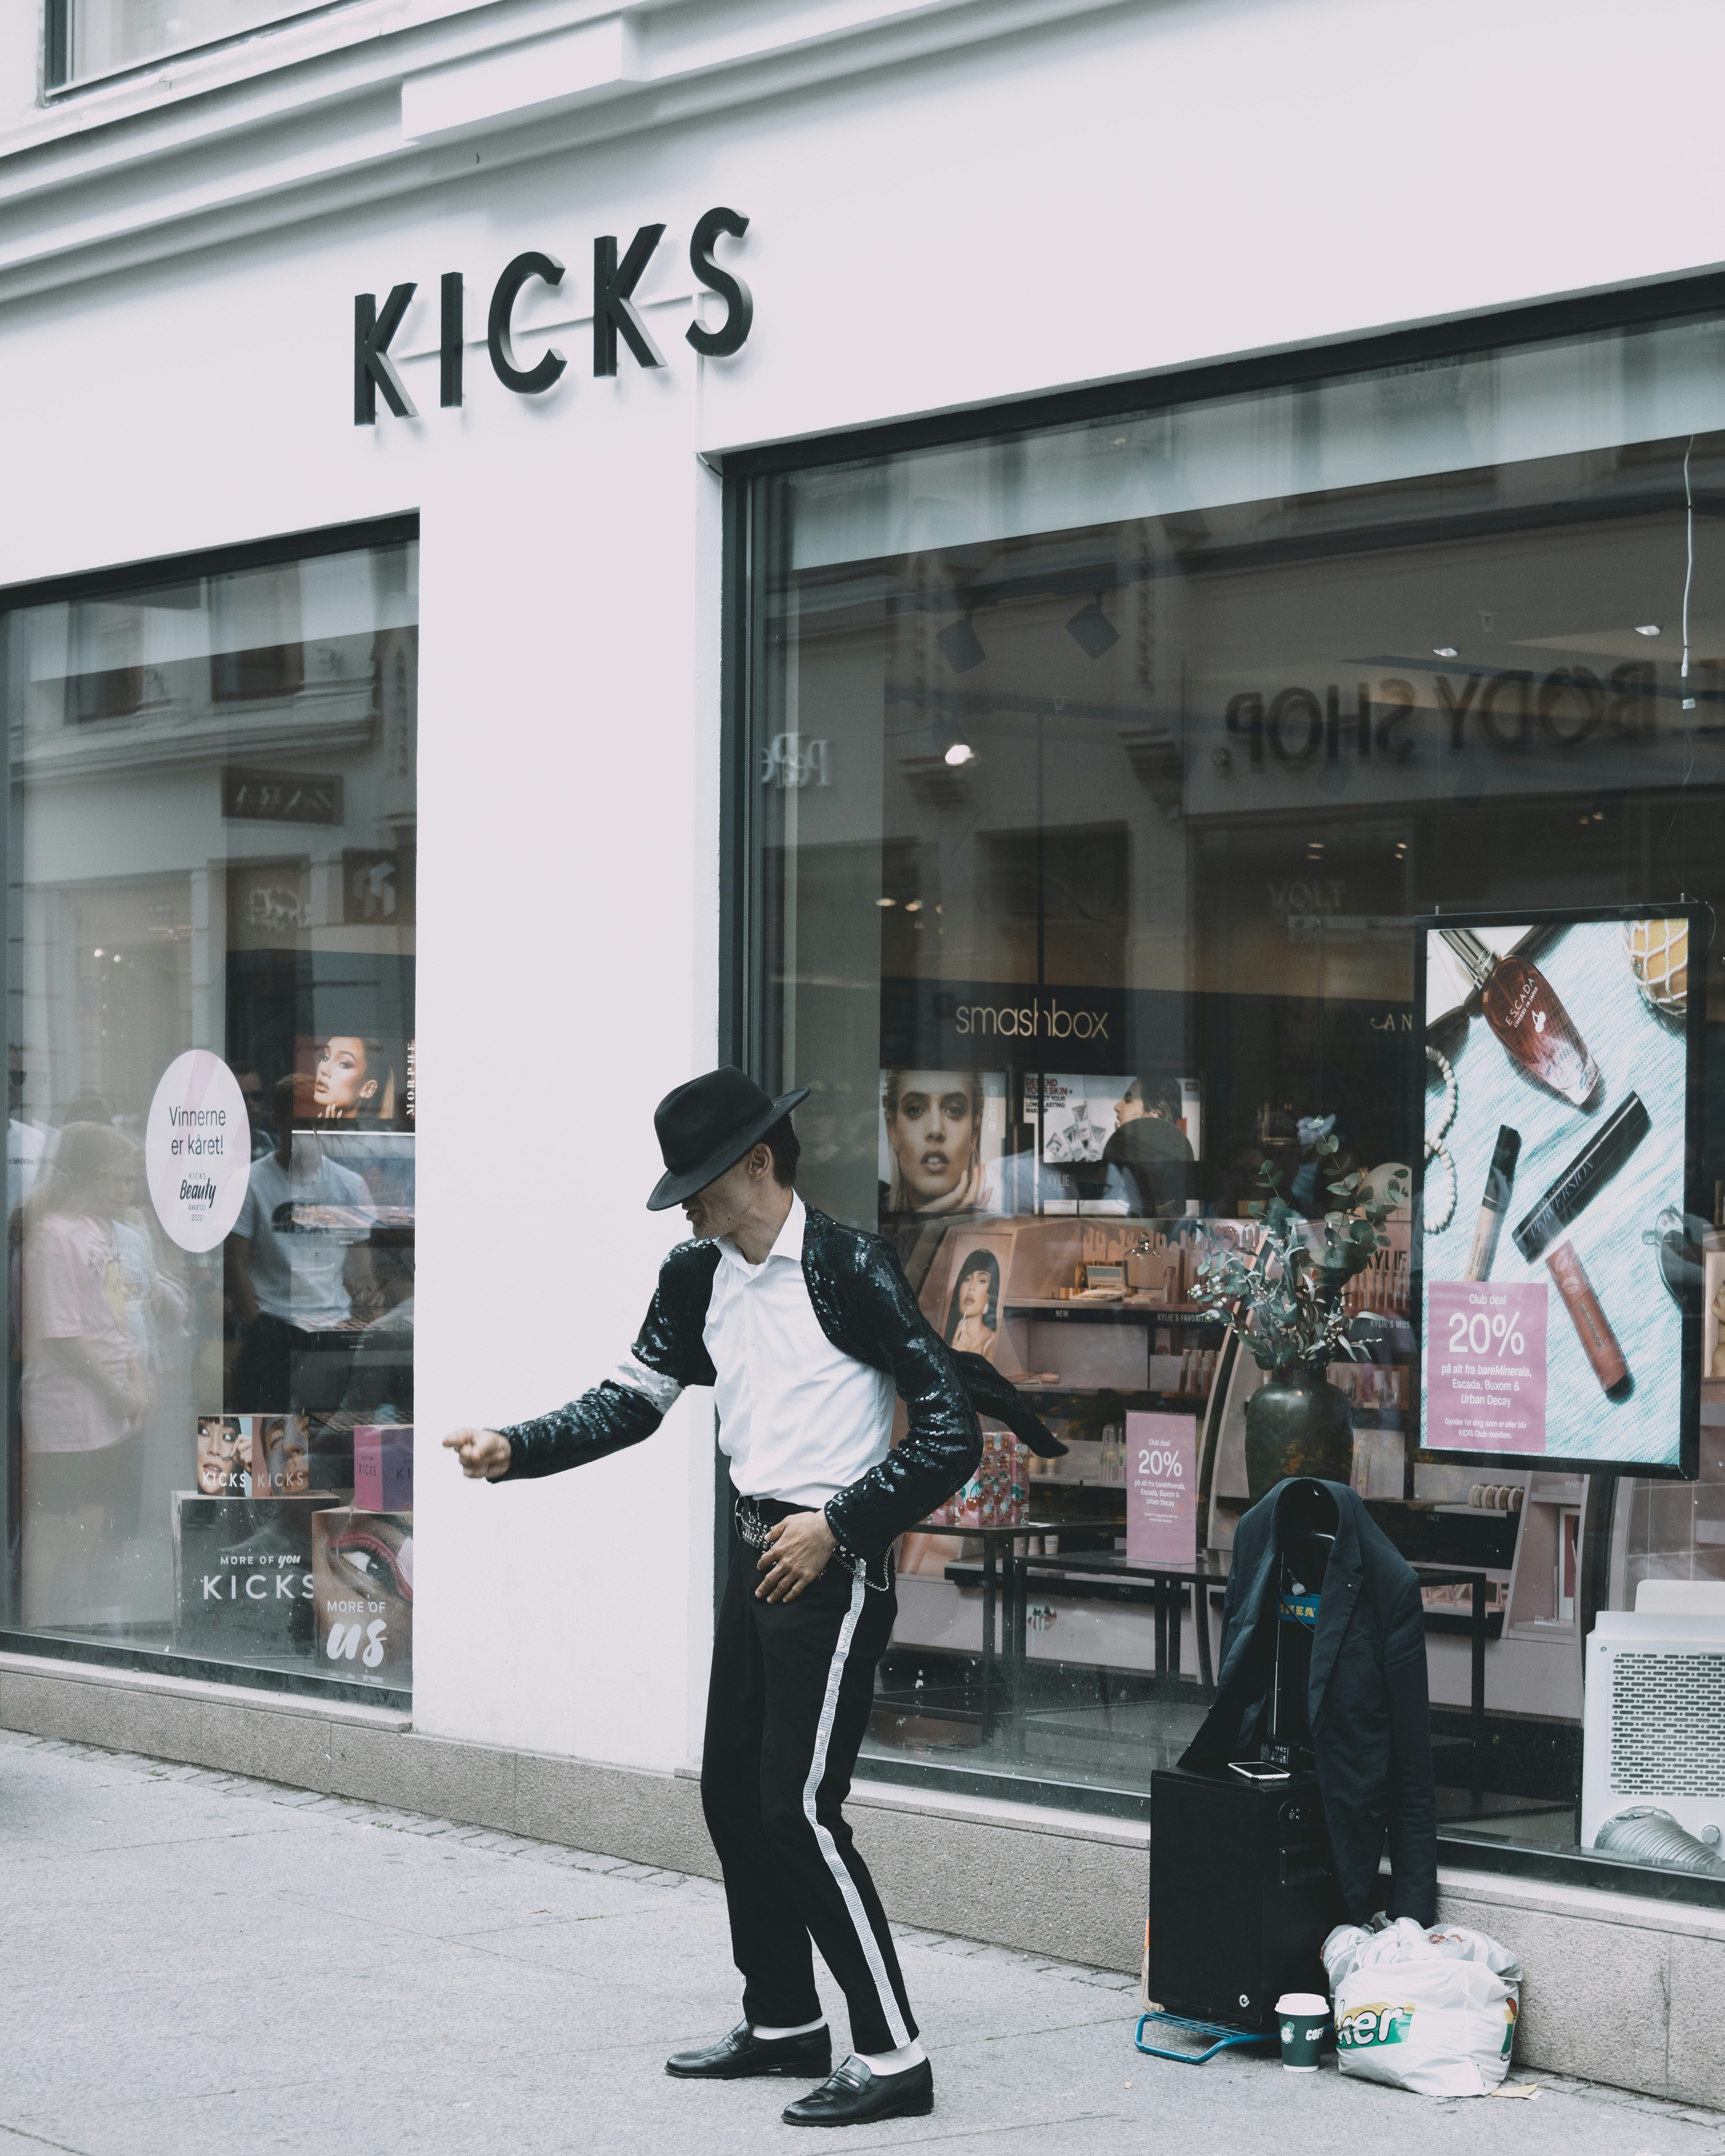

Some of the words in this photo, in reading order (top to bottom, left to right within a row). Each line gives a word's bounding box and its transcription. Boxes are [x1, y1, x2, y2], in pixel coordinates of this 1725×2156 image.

[354, 207, 753, 427] KICKS
[1505, 978, 1535, 1026] ESCADA
[1514, 1007, 1527, 1028] CHERRY
[1525, 1000, 1531, 1009] IN
[1529, 986, 1538, 1002] JAPAN
[956, 997, 1109, 1039] smashbox
[407, 1043, 415, 1116] MORPHE
[169, 1106, 226, 1126] Vinnerne
[171, 1139, 183, 1155] er
[188, 1134, 223, 1155] kåret!
[180, 1177, 216, 1209] Beauty
[1530, 1158, 1593, 1239] PERVERSION
[1469, 1294, 1487, 1304] Club
[1489, 1295, 1506, 1305] deal
[1157, 1313, 1179, 1322] KYLIE'S
[1370, 1320, 1394, 1328] KYLIE'S
[1448, 1311, 1525, 1358] 20%
[1441, 1363, 1451, 1376] på
[1453, 1363, 1463, 1374] alt
[1465, 1363, 1475, 1374] fra
[1477, 1364, 1532, 1378] bareMinerals,
[1452, 1378, 1483, 1391] Escada,
[1485, 1380, 1511, 1391] Buxom
[1513, 1381, 1520, 1392] &
[1461, 1393, 1484, 1405] Urban
[1487, 1395, 1511, 1409] Decay
[1444, 1418, 1464, 1426] Gjelder
[1472, 1419, 1484, 1429] deg
[359, 1464, 376, 1477] KICKS
[1139, 1449, 1182, 1478] 20%
[203, 1472, 246, 1488] KICKS
[257, 1472, 304, 1487] KICKS
[1141, 1488, 1158, 1496] Escada,
[1160, 1499, 1174, 1508] Decay
[220, 1556, 253, 1565] MORE
[259, 1555, 274, 1565] OF
[278, 1555, 301, 1569] you
[203, 1574, 314, 1600] KICKS
[327, 1601, 364, 1613] MORE
[368, 1601, 386, 1613] OF
[1279, 1603, 1315, 1618] IKEA
[326, 1618, 388, 1668] us
